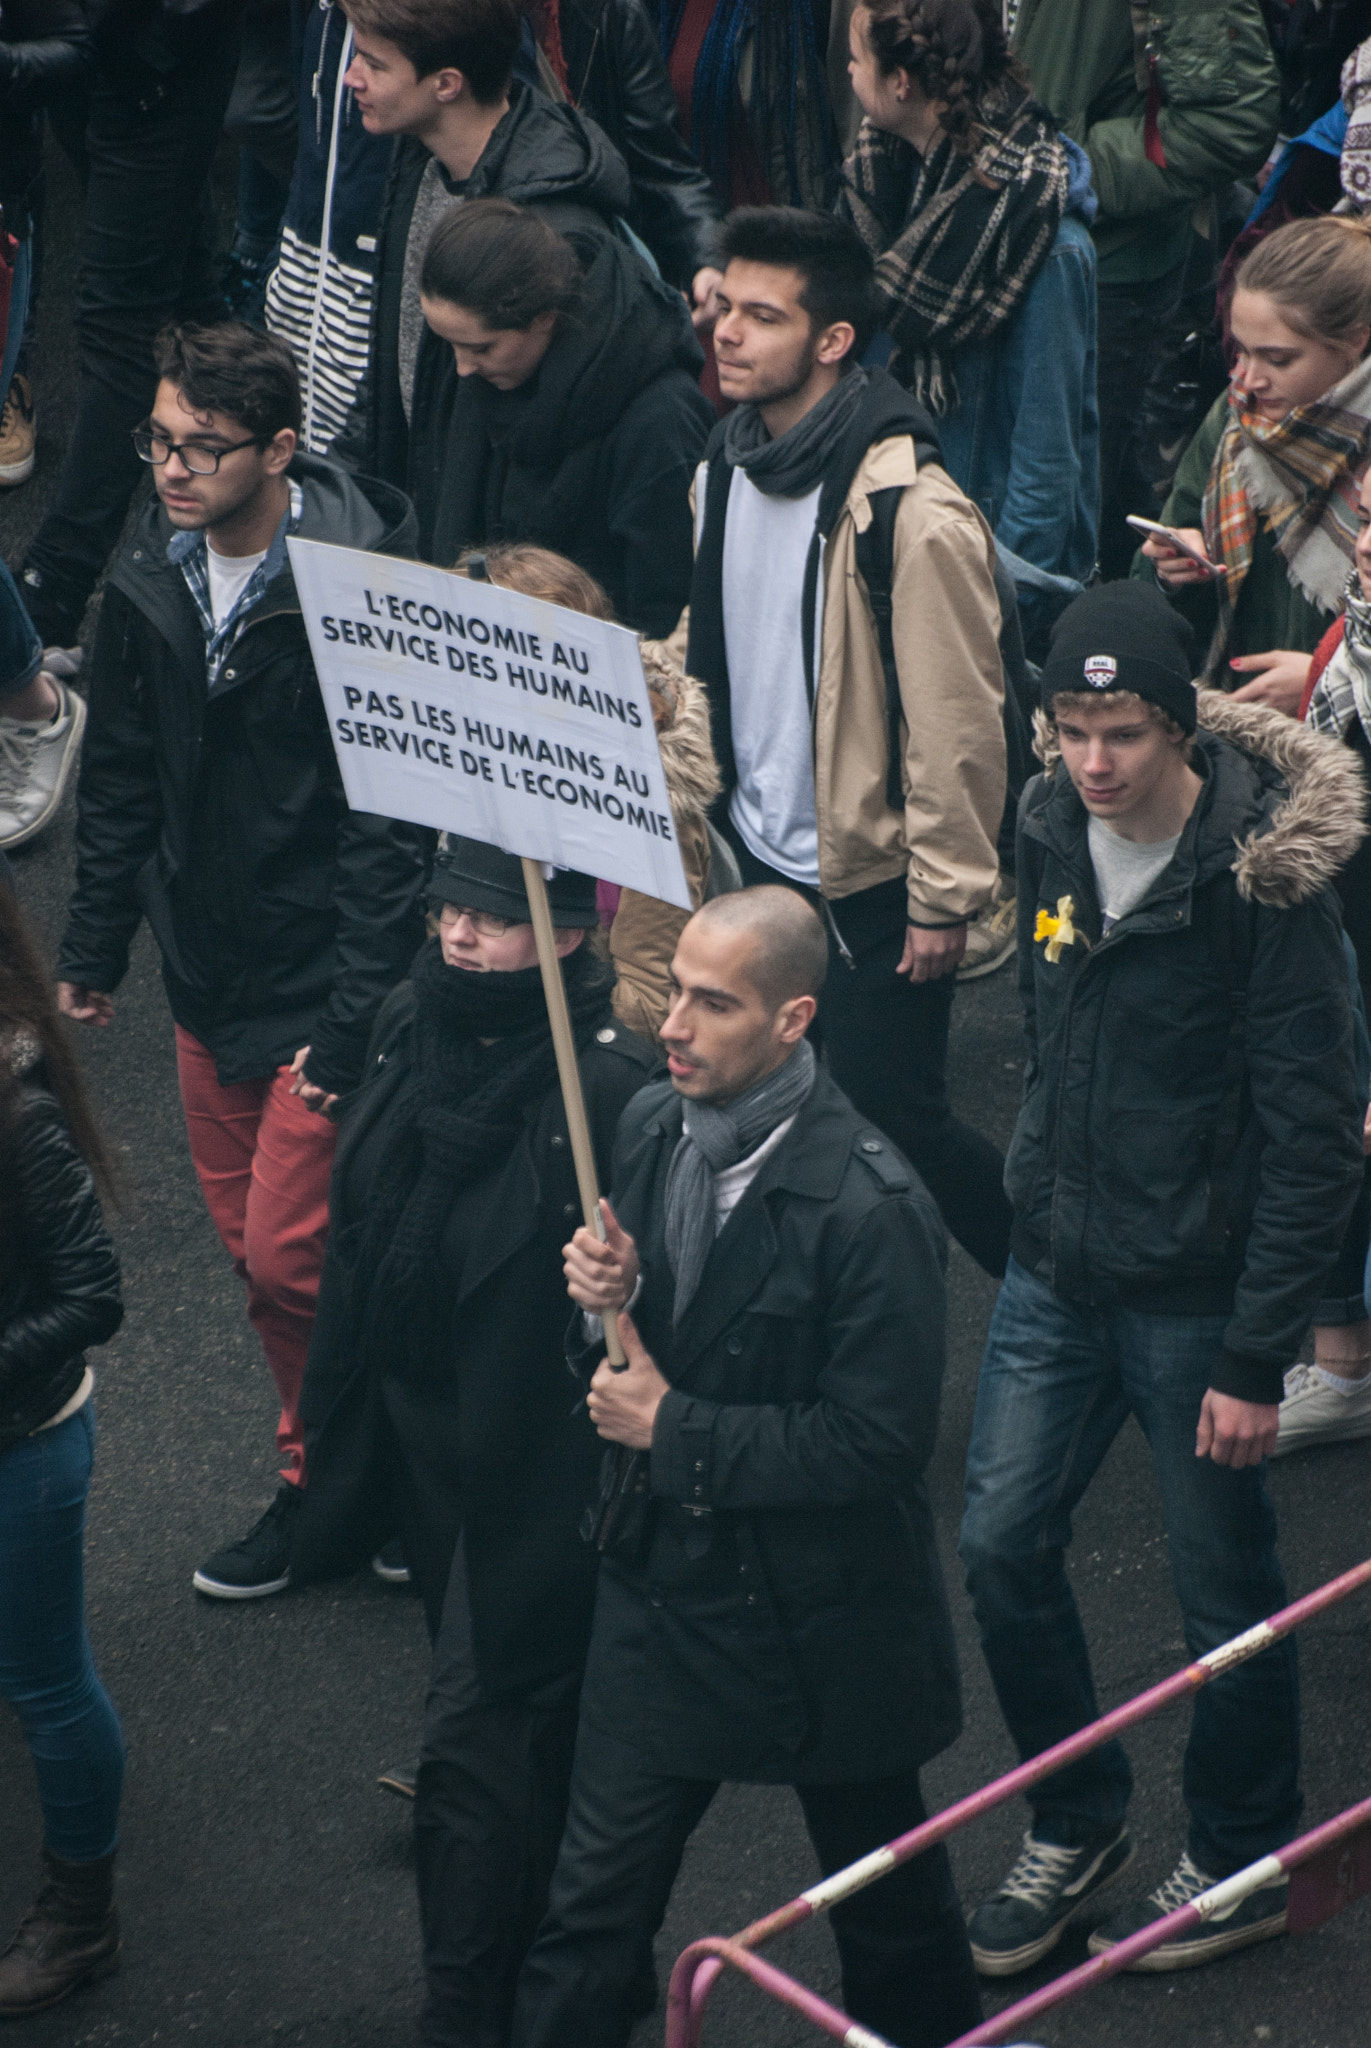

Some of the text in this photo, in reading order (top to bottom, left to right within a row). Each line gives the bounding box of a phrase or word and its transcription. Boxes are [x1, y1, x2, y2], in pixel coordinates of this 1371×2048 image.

[320, 615, 642, 729] SERVICE DES HUMAINS
[363, 589, 590, 676] L'ECONOMIE AU
[335, 718, 672, 841] SERVICE DE L'ECONOMIE
[342, 685, 650, 799] PAS LES HUMAINS AU
